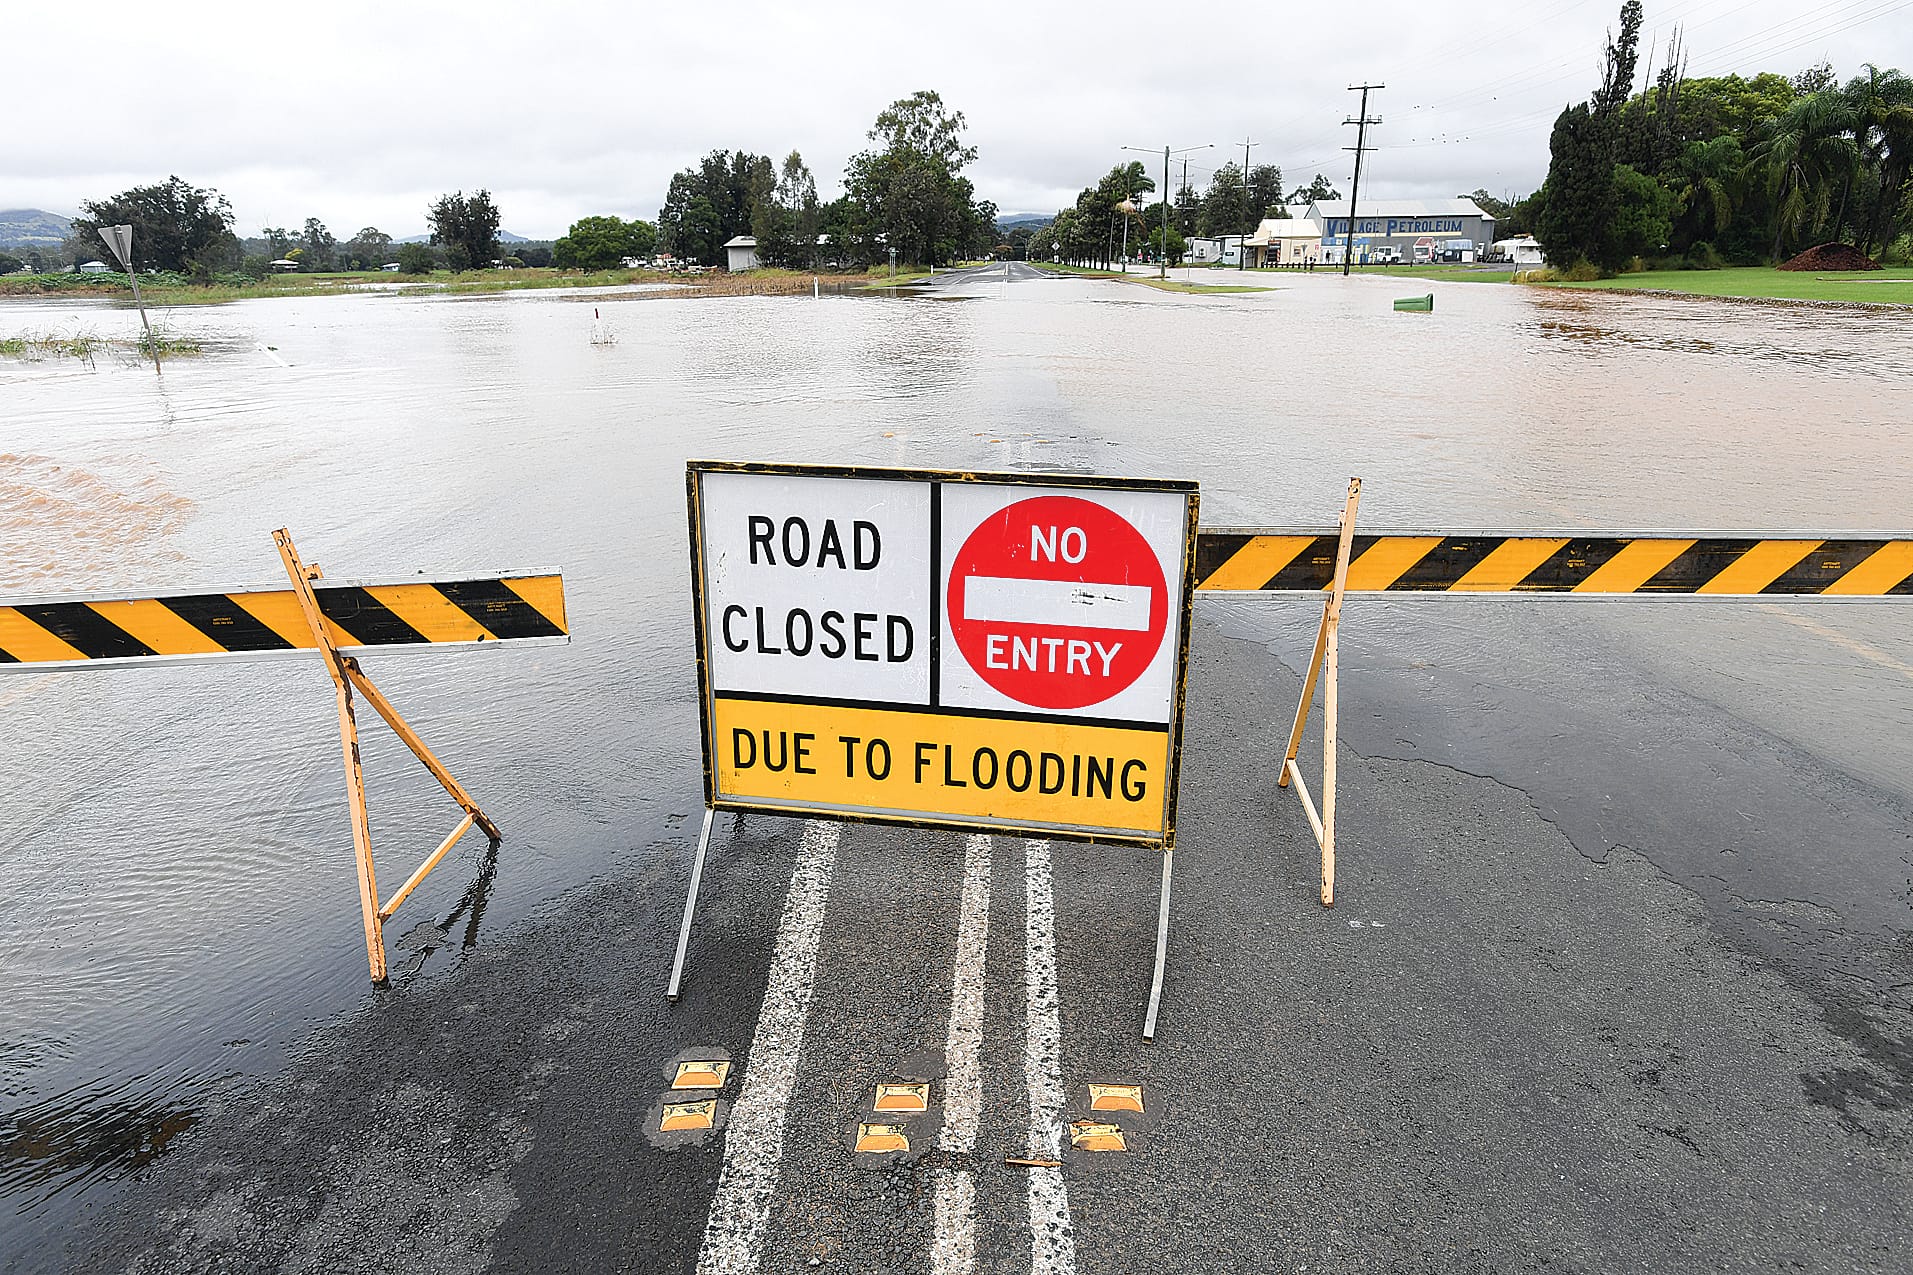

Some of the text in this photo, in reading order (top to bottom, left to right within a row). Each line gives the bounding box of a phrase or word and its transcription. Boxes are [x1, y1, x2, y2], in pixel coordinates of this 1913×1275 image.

[1326, 219, 1463, 238] VILAGE PETROLEUM
[748, 515, 882, 571] ROAD
[1029, 524, 1088, 565] NO
[722, 604, 915, 663] CLOSED
[985, 634, 1124, 678] ENTRY
[732, 727, 1148, 803] DUE TO FLOODING
